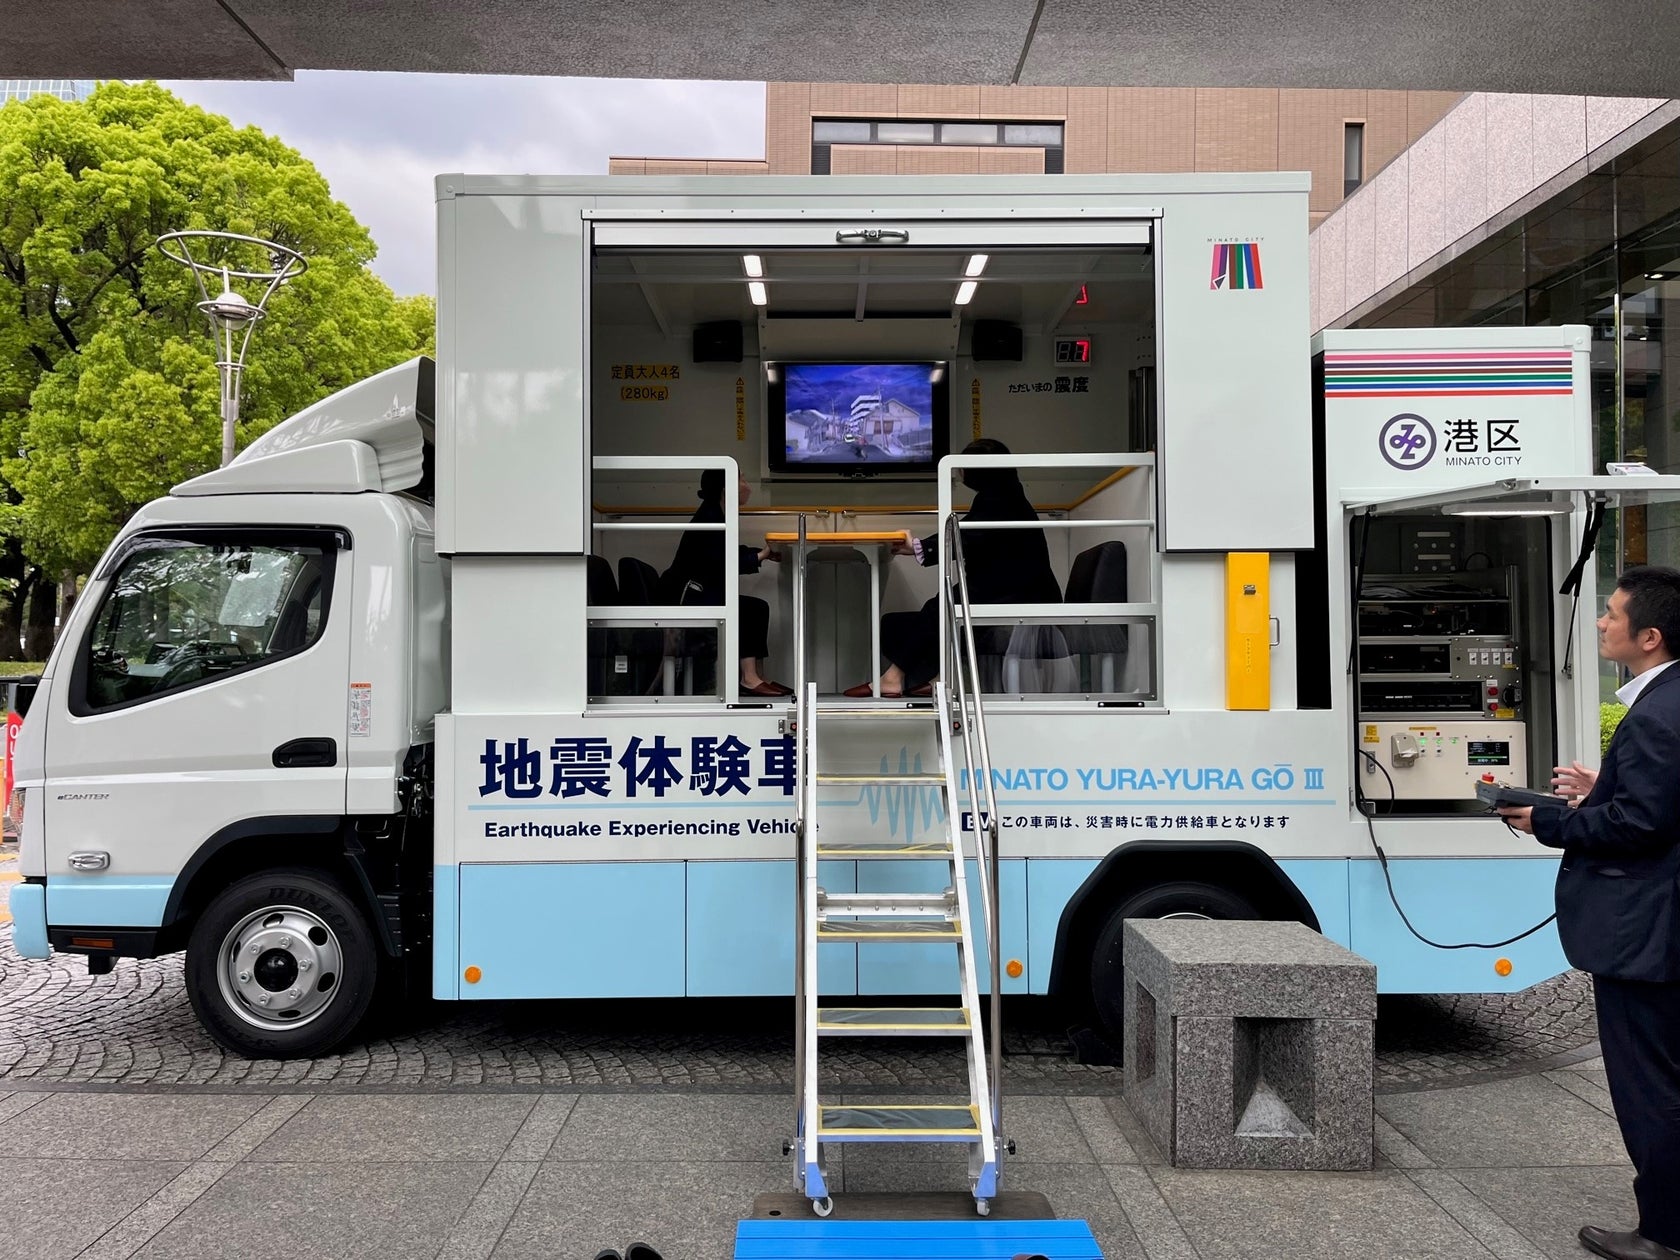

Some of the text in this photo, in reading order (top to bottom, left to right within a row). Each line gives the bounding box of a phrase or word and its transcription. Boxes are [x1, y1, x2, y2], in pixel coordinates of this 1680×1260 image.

[1076, 340, 1089, 362] 7
[611, 365, 680, 379] 定員大人4名
[621, 386, 669, 401] (280kg)
[1009, 376, 1089, 393] ただいまの震度
[1444, 419, 1521, 453] 港区
[1446, 456, 1521, 466] MINATO CITY
[479, 734, 809, 799] 地震体験車
[961, 768, 1068, 791] MNATO
[1076, 767, 1244, 791] YURA-YURA
[485, 819, 819, 838] Earthquake Experiencing Vehic
[1001, 815, 1290, 829] この車両は、災害時に電力供給車となります
